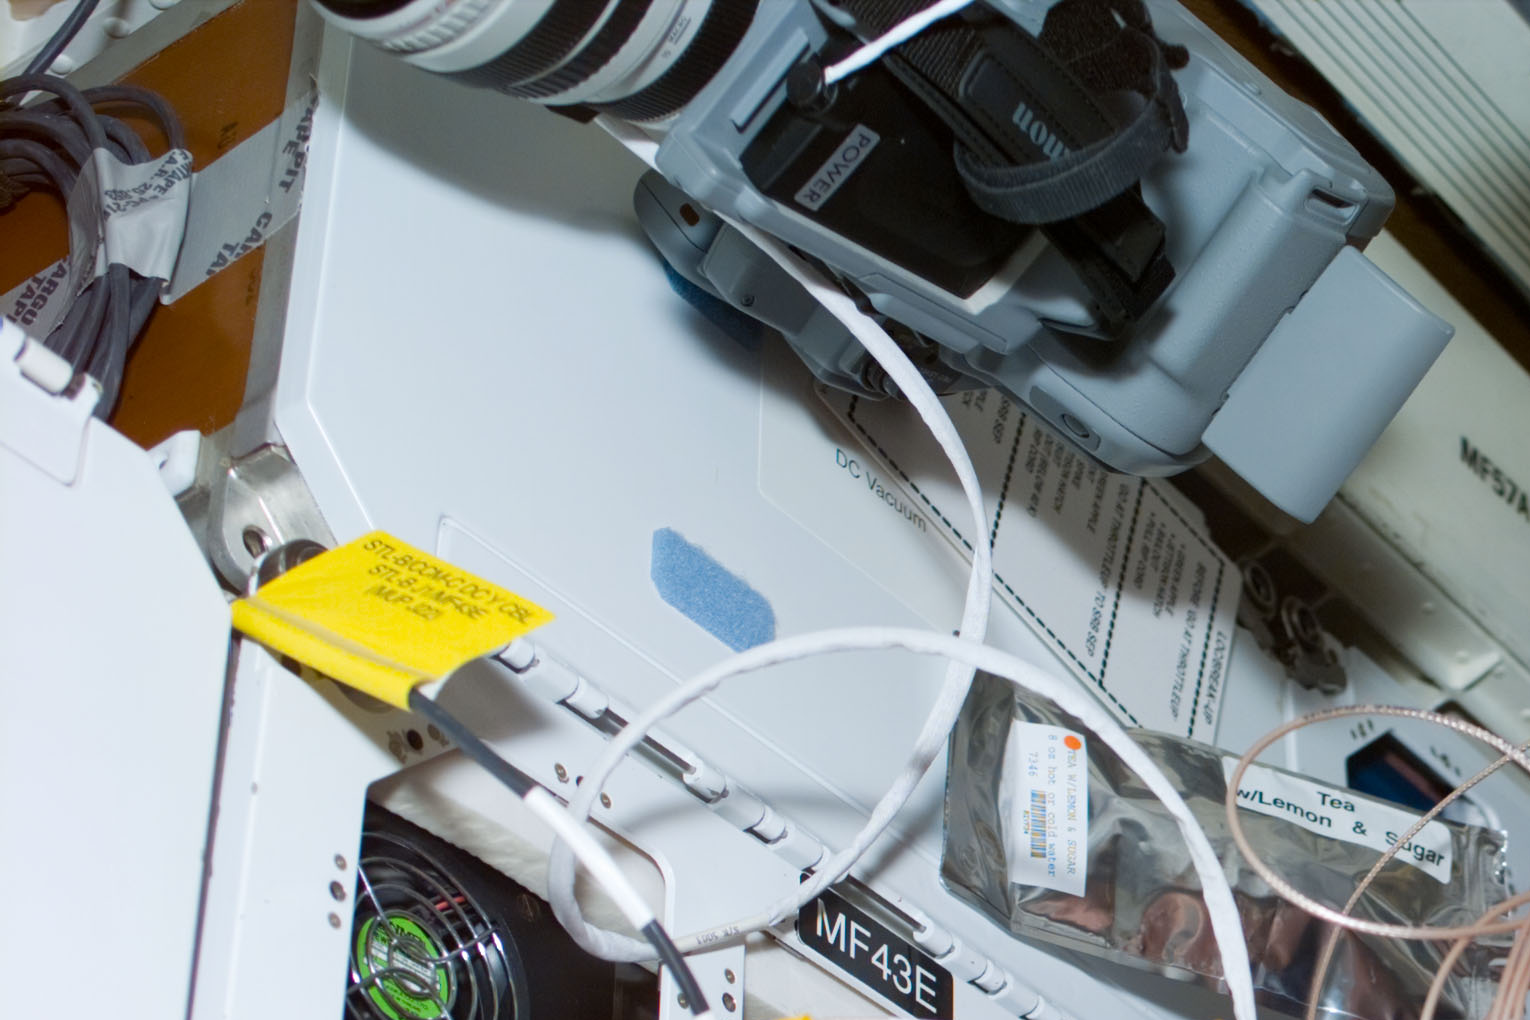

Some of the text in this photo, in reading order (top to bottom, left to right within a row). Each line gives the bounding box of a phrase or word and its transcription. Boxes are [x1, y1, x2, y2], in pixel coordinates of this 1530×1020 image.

[1012, 101, 1070, 159] non
[803, 133, 871, 203] POWER
[21, 259, 70, 326] ARGO
[835, 448, 928, 533] DC Vacuum
[1094, 591, 1105, 607] TO
[1089, 607, 1101, 633] SRB
[1083, 632, 1096, 657] SEP
[1047, 766, 1056, 785] hot
[1067, 750, 1077, 767] TEA
[1066, 774, 1077, 820] W/LEMON
[1316, 791, 1355, 812] Tea
[1046, 812, 1057, 838] cold
[1236, 789, 1445, 866] w/Lemon & Sugar
[1046, 842, 1056, 876] water
[1066, 840, 1075, 874] SUGAR
[816, 897, 937, 1014] MF43E
